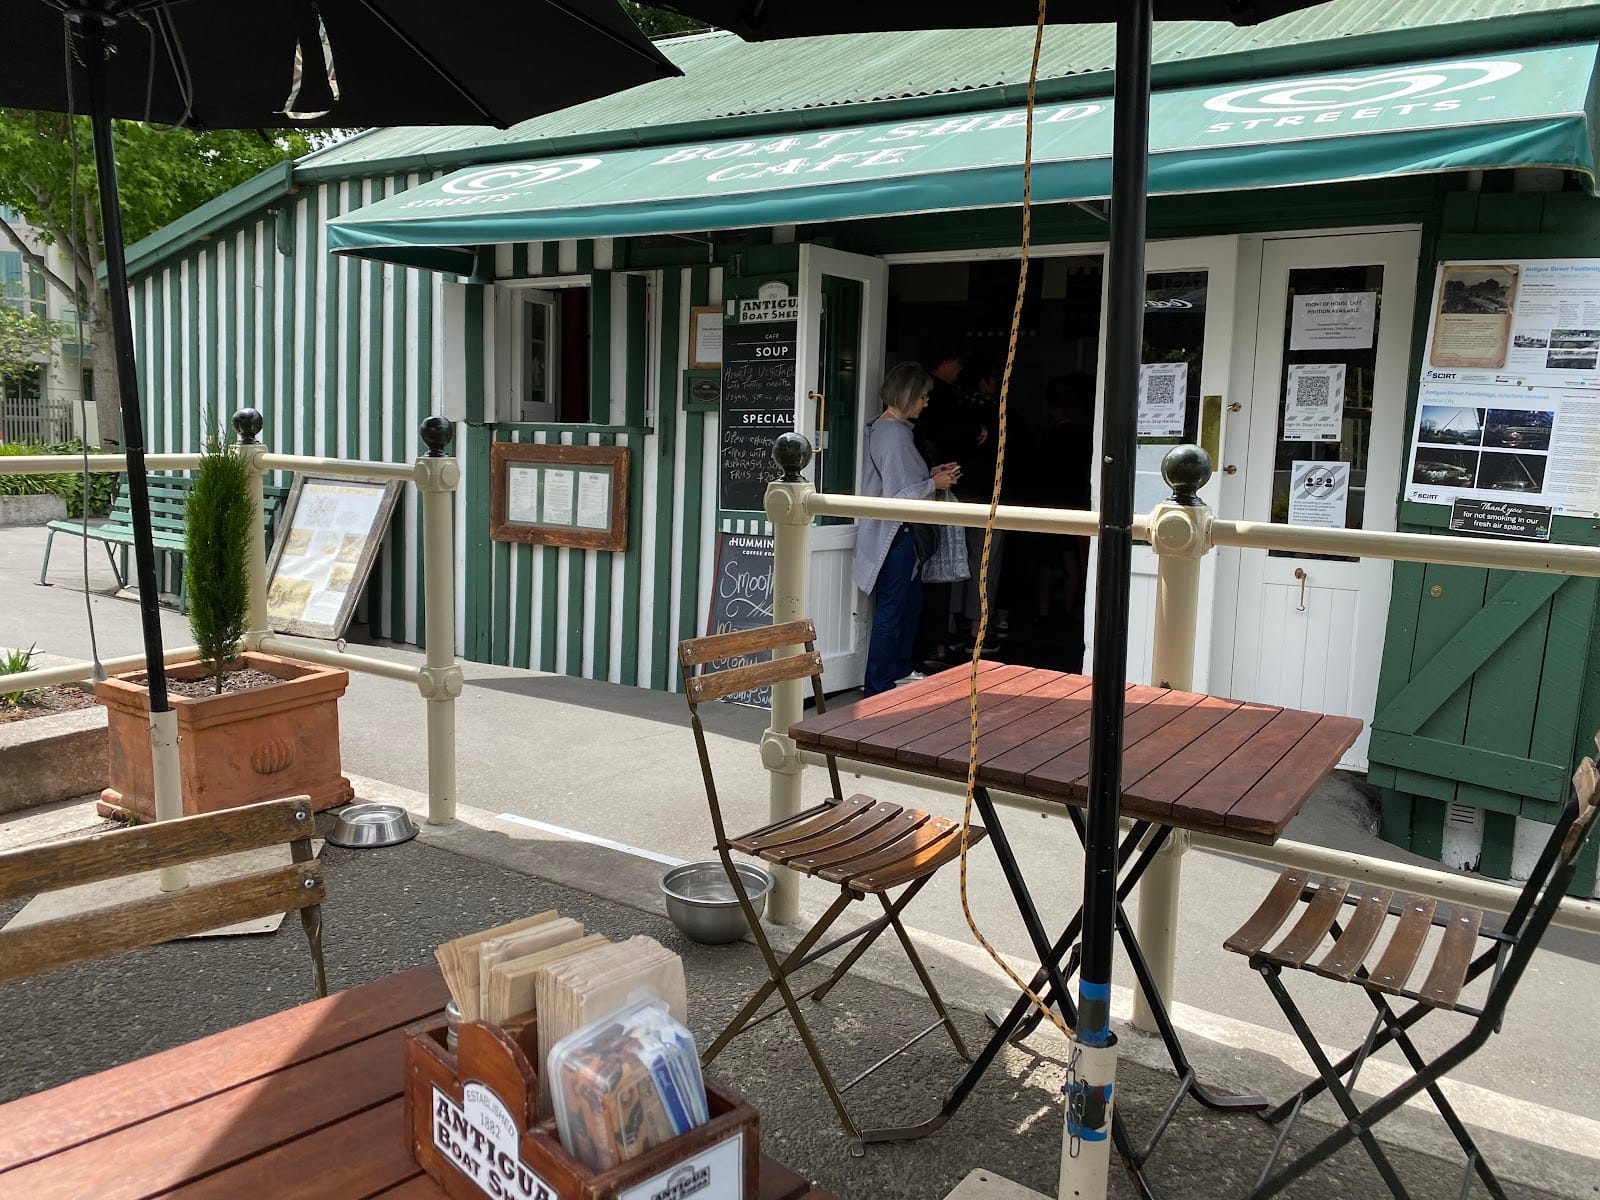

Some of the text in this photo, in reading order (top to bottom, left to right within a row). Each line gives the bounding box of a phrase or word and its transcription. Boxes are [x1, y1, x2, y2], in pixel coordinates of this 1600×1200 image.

[1204, 98, 1461, 134] STREETS
[651, 104, 1106, 165] BOAT SHED
[399, 192, 519, 209] STREETS
[742, 299, 798, 311] ANTIGU
[755, 346, 789, 357] SOUP
[1432, 372, 1457, 380] SCIRT
[1480, 502, 1507, 513] Thank
[1463, 510, 1473, 518] for
[1486, 513, 1517, 524] smoking
[1473, 520, 1491, 528] fresh
[1492, 521, 1502, 529] air
[1503, 524, 1525, 532] space
[728, 537, 774, 549] HUMMIN
[466, 1089, 515, 1137] ESTABLISHED
[480, 1113, 501, 1139] 1882
[437, 1121, 481, 1177] BOAT
